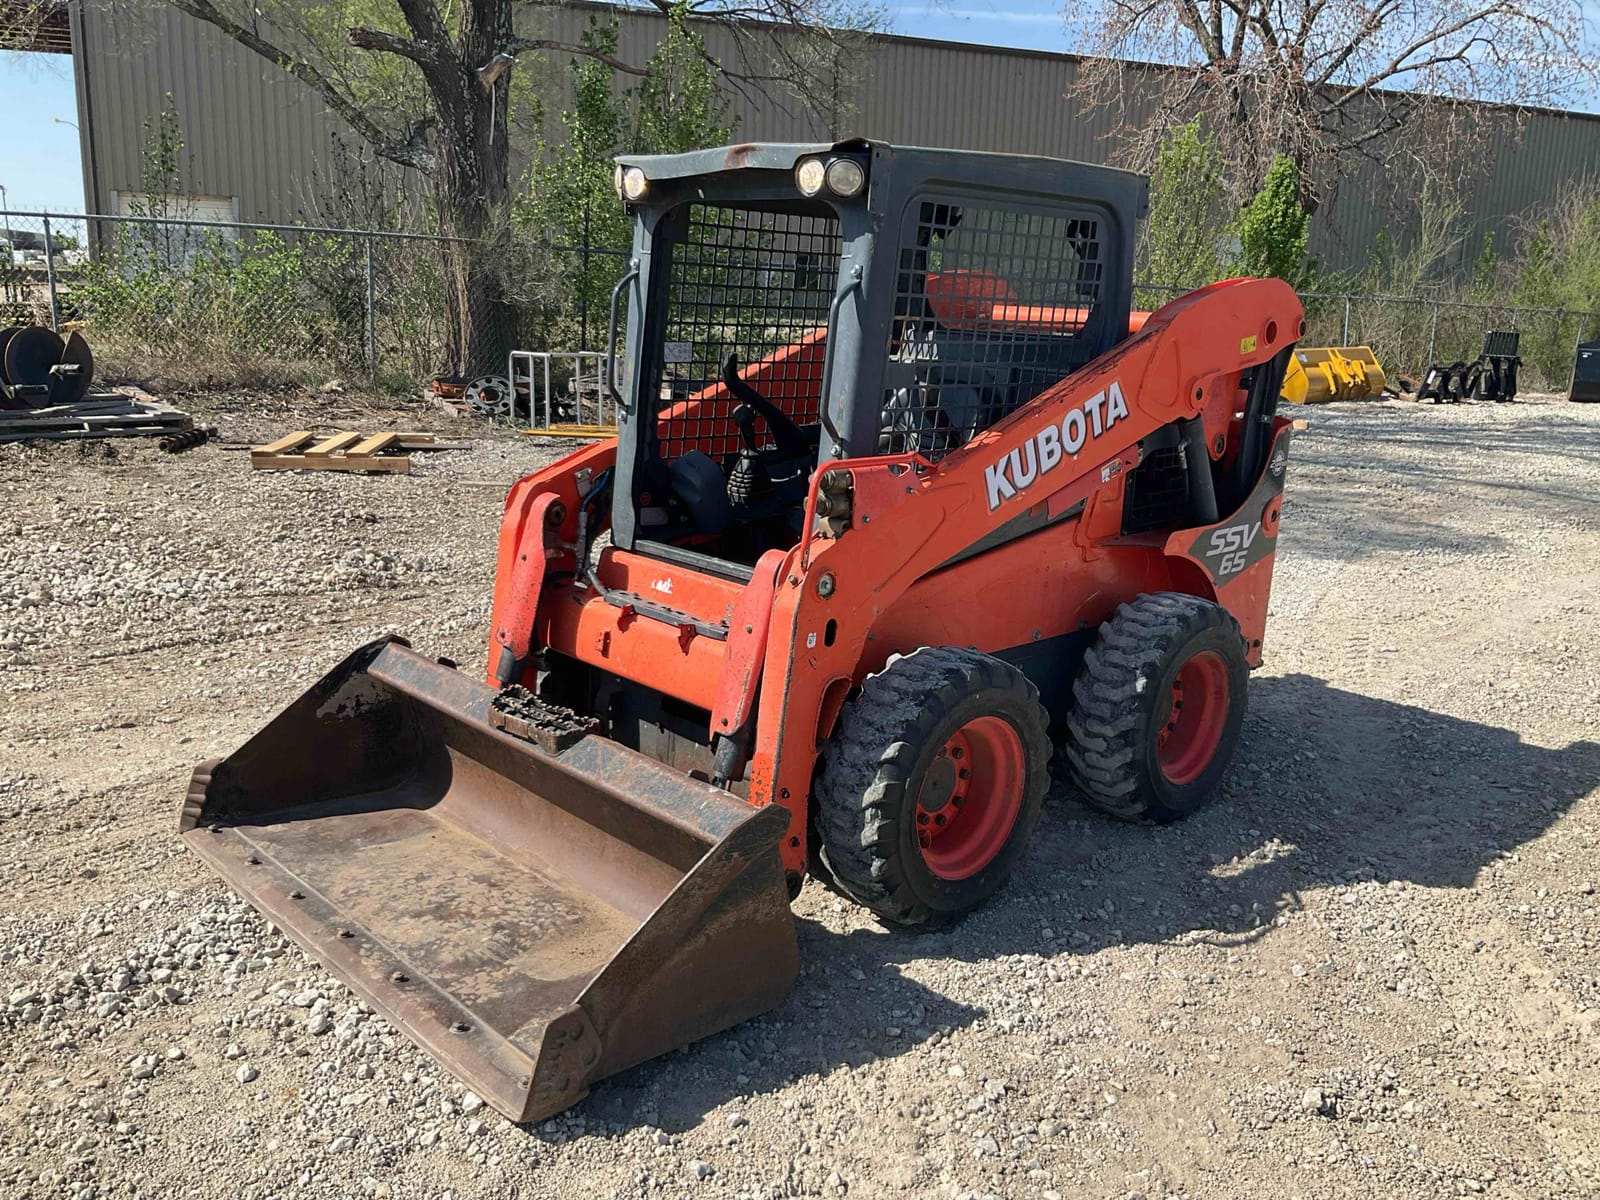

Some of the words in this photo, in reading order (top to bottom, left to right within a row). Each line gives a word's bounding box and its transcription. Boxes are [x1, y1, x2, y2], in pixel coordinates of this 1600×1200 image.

[985, 380, 1129, 512] KUBOTA
[1206, 521, 1261, 557] SSV
[1218, 550, 1248, 576] 65
